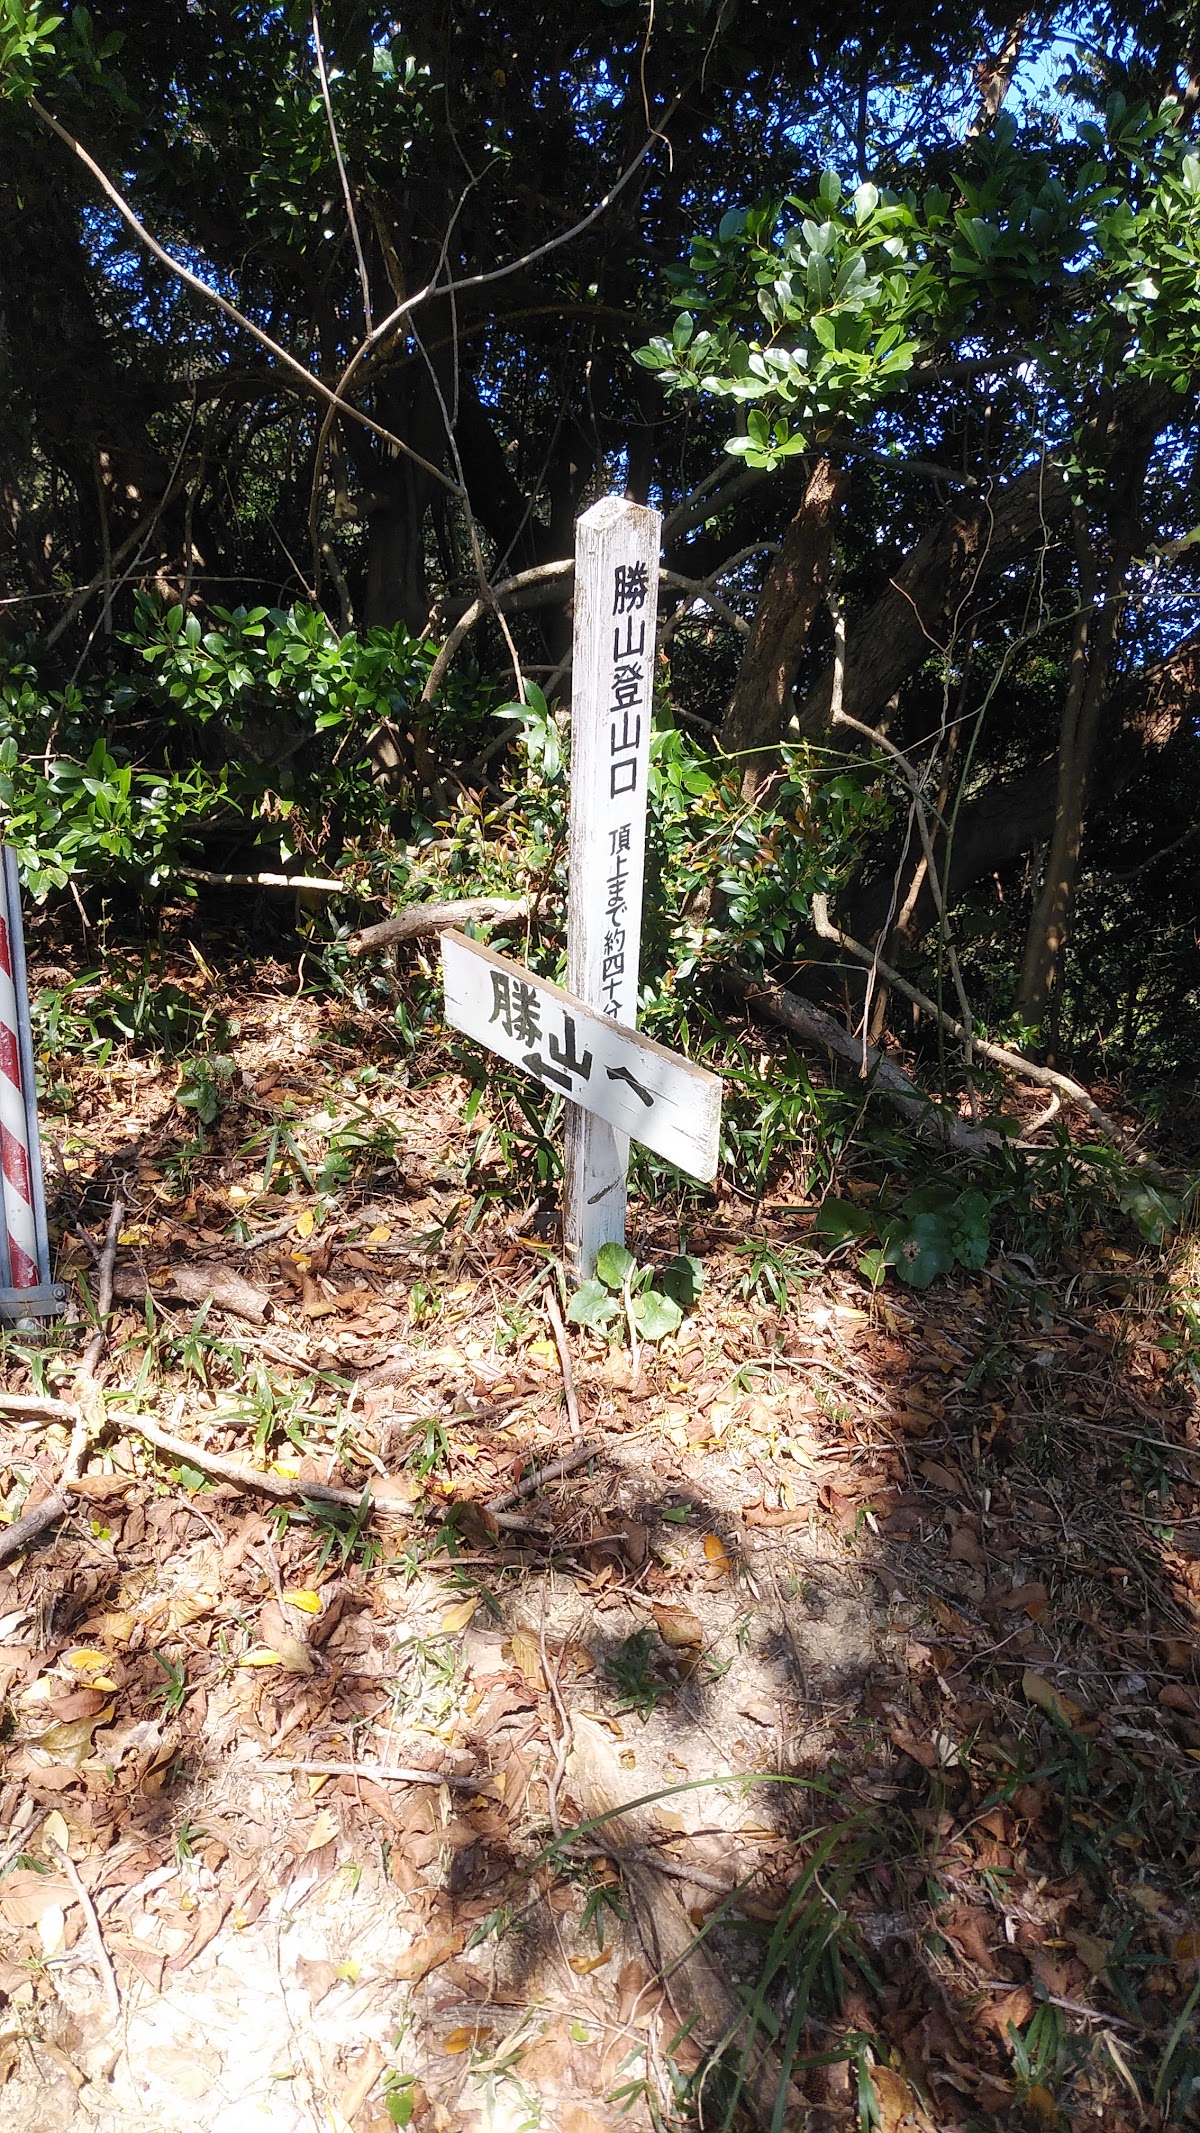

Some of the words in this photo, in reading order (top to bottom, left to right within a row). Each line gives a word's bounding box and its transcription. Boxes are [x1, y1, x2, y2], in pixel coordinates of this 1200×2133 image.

[609, 561, 649, 799] 勝山登山口
[489, 970, 654, 1107] 勝山へ
